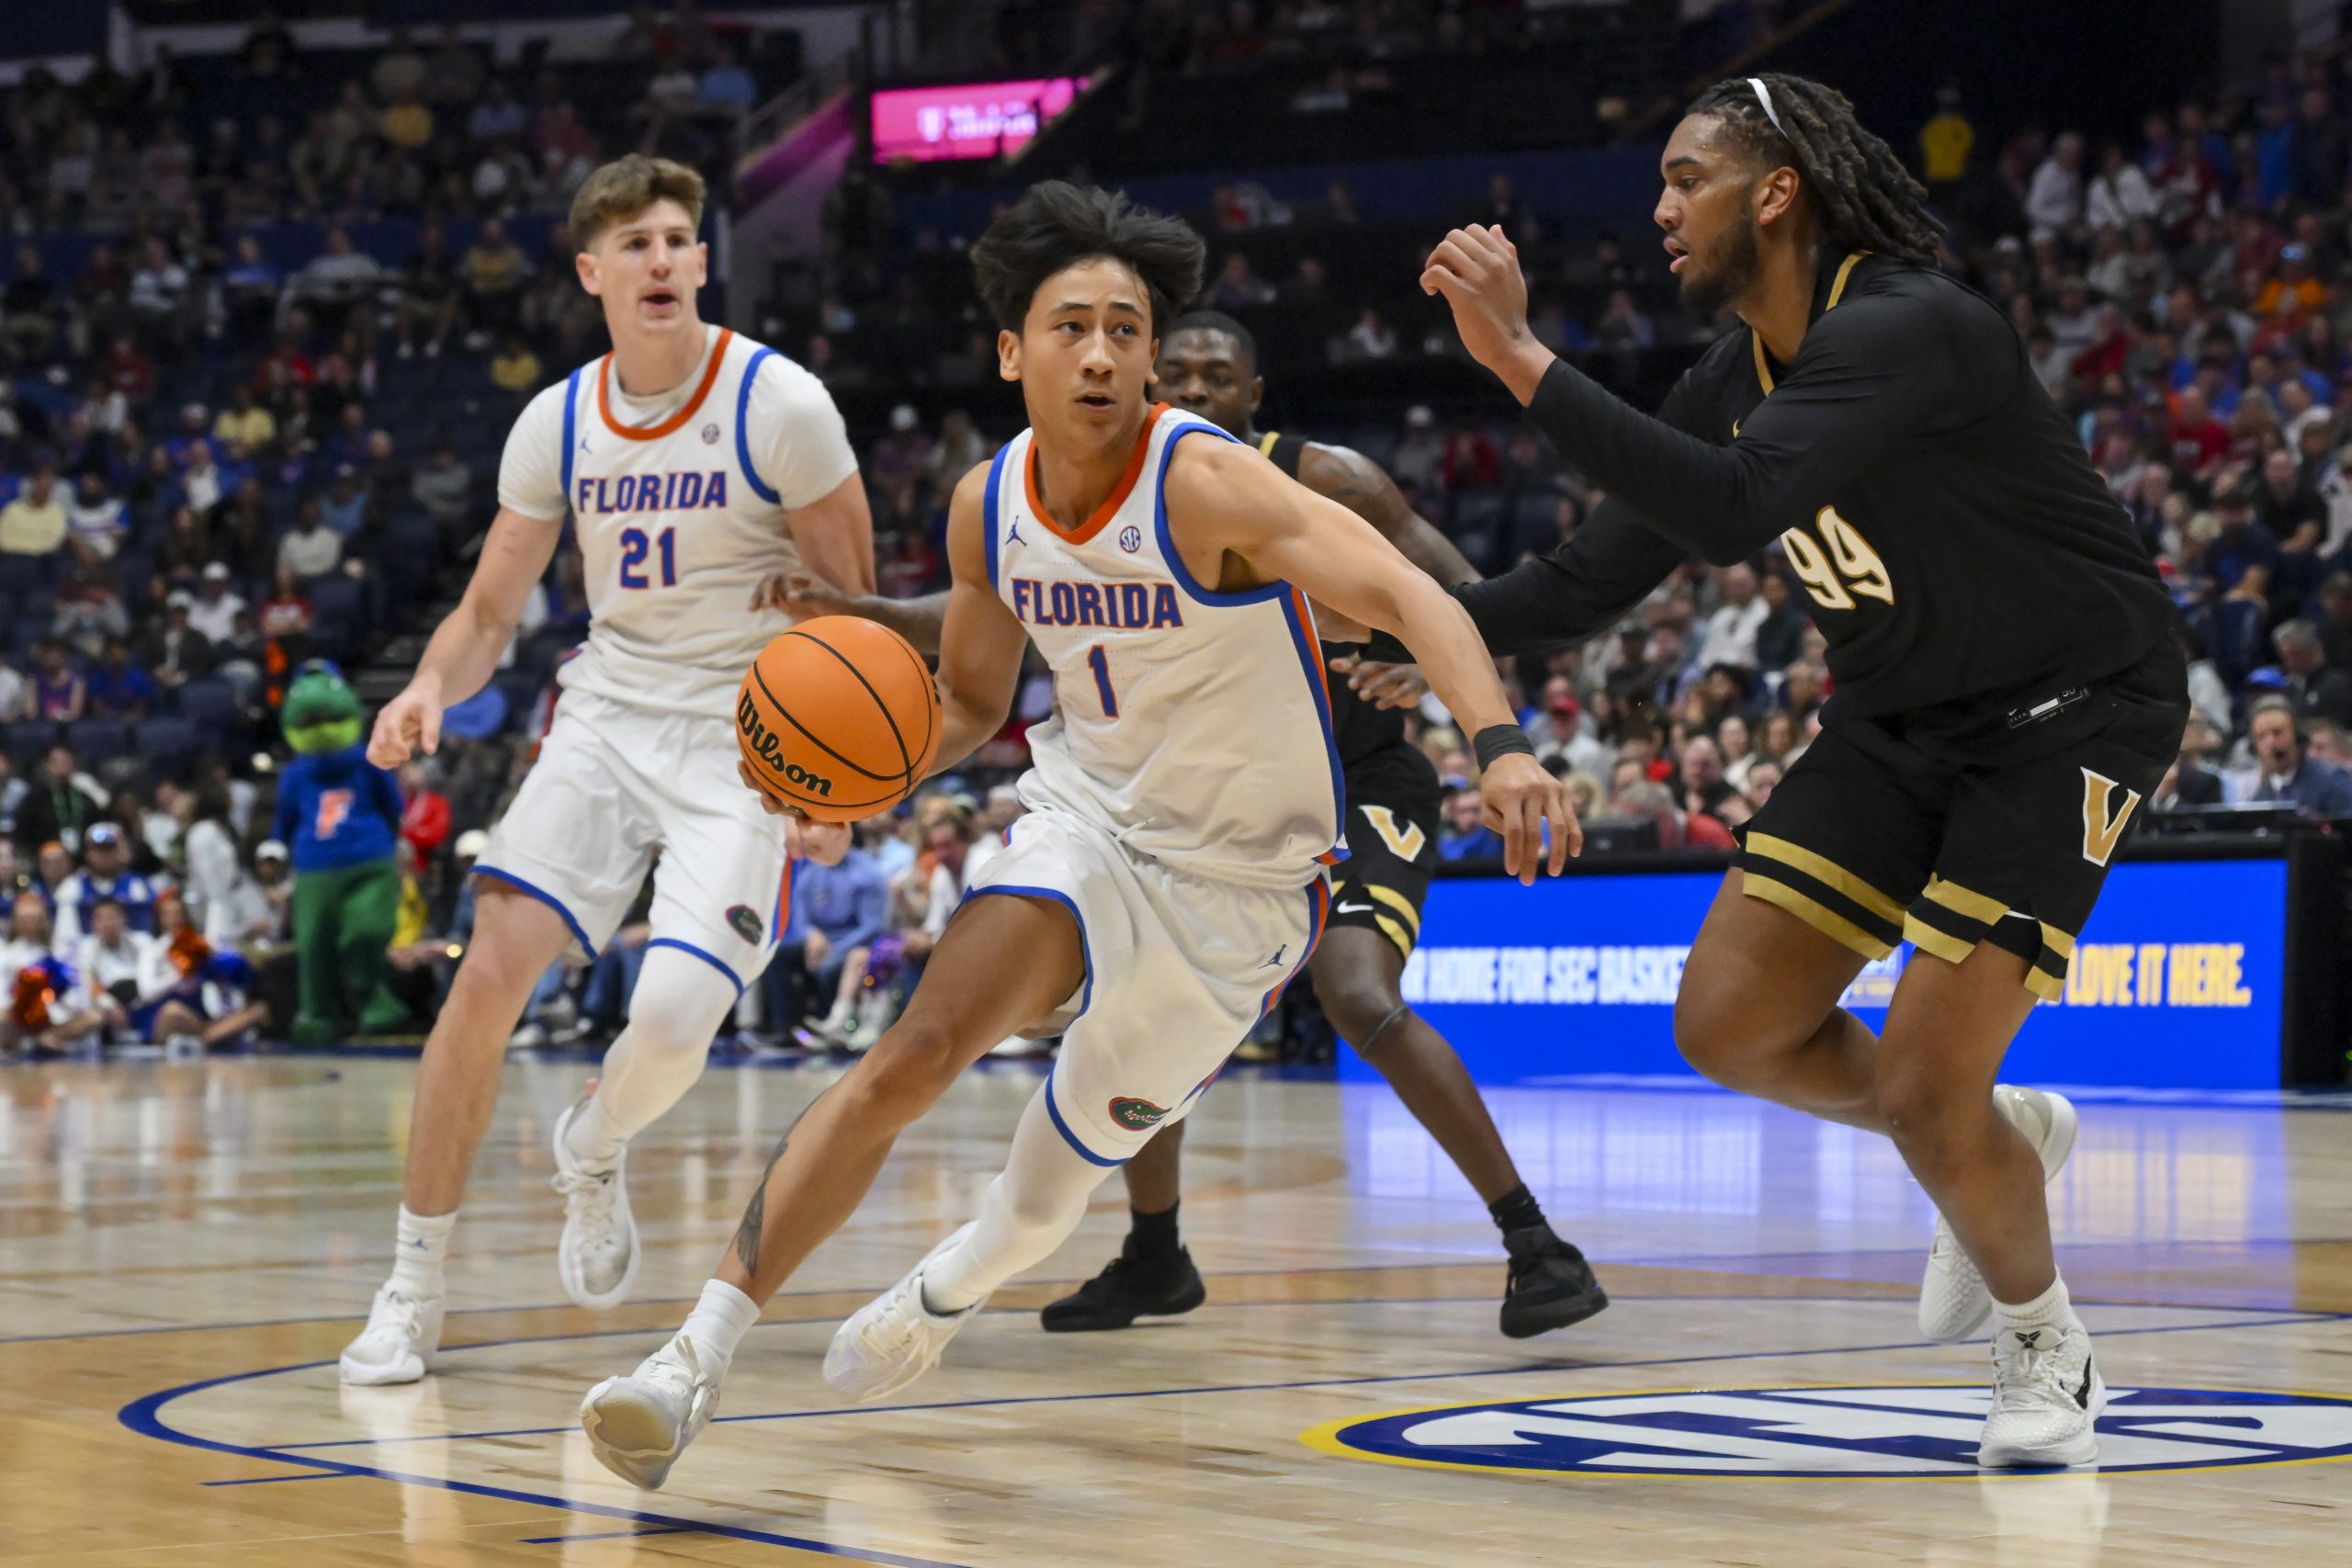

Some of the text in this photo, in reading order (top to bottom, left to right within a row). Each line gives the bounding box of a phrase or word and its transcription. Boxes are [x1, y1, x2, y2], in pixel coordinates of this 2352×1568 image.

[578, 471, 727, 513] FLORIDA
[620, 526, 676, 589] 21
[1781, 504, 1894, 610] 99
[1012, 578, 1184, 629] FLORIDA
[1088, 645, 1119, 719] 1
[739, 688, 831, 796] Wilson
[315, 788, 355, 840] F
[1358, 805, 1426, 863] V
[2080, 766, 2142, 867] V
[1429, 947, 1497, 1002] HOME
[1499, 947, 1546, 1003] FOR
[1548, 947, 1596, 1003] SEC
[2065, 943, 2252, 1008] LOVE IT HERE.
